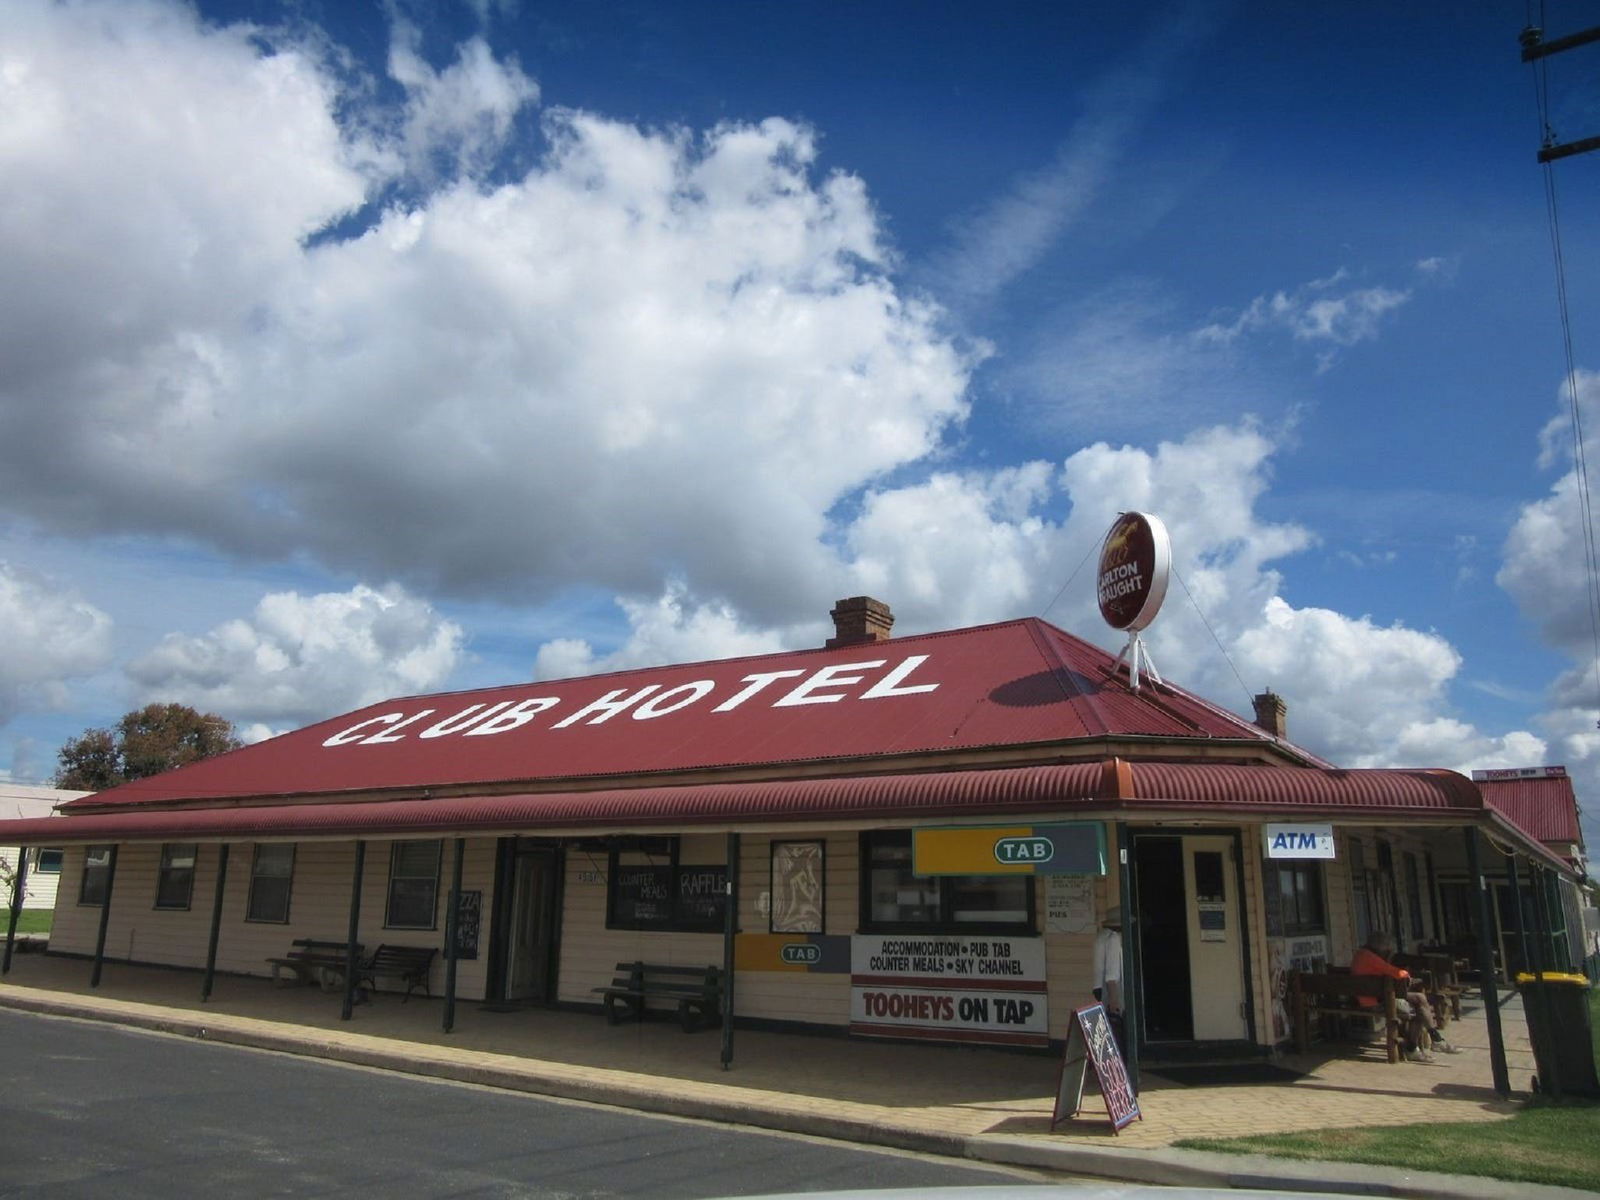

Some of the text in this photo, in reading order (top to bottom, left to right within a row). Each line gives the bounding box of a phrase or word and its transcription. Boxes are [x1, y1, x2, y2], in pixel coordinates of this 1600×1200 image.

[1099, 560, 1138, 589] ARLTON
[1099, 575, 1142, 603] RAUGHT
[323, 655, 941, 748] CLUB HOTEL
[1003, 843, 1046, 858] TAB
[1272, 832, 1317, 850] ATM
[788, 946, 815, 960] TAB
[881, 941, 1011, 958] ACCOMMODATION PUB TAB
[870, 957, 1024, 976] COUNTER MEALS SKY CHANNEL
[862, 992, 1034, 1025] TOOHEYS ON TAP
